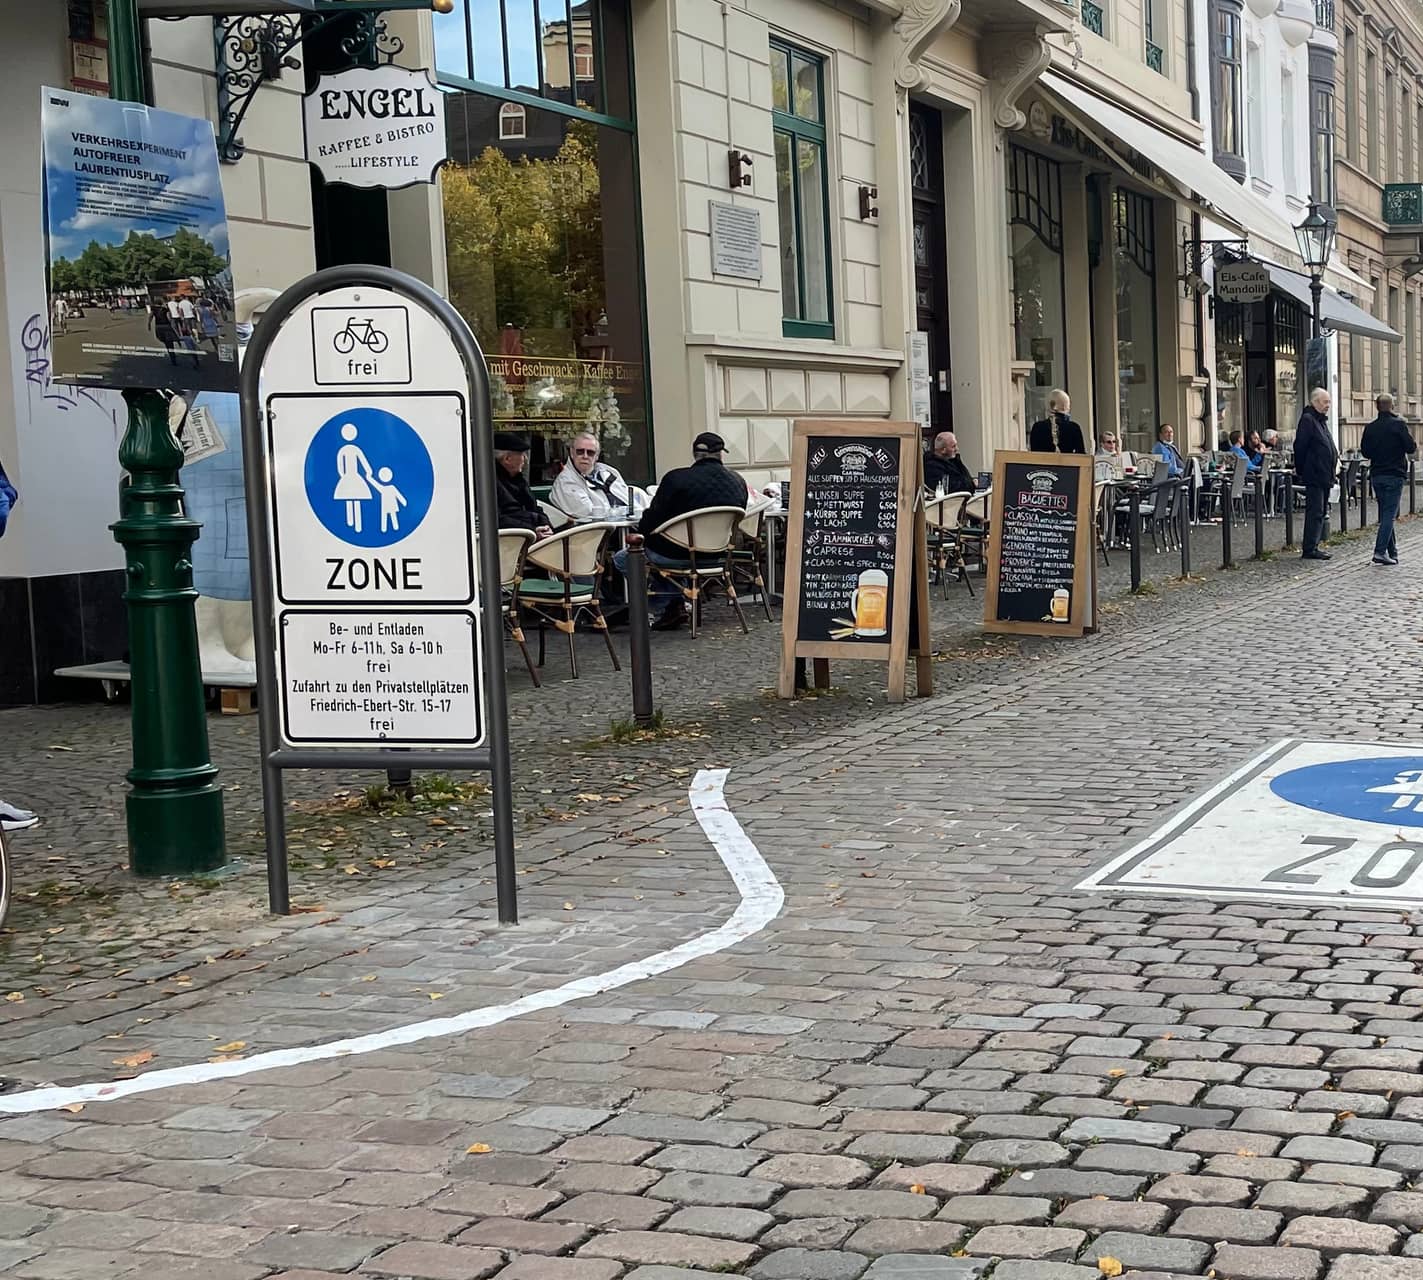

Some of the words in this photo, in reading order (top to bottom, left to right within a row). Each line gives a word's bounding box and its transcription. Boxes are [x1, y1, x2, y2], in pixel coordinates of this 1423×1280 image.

[320, 88, 436, 119] ENGEL
[72, 132, 186, 160] VERKEHRSEXPERIMENT
[318, 135, 371, 157] KAFFEE
[375, 133, 383, 144] &
[387, 122, 434, 142] BISTRO
[73, 147, 141, 166] AUTOFREIER
[75, 162, 171, 185] LAURENTIUSPLATZ
[348, 359, 377, 375] frei
[490, 360, 510, 377] mit
[512, 360, 574, 378] Geschmack
[583, 363, 614, 380] Kaffee
[809, 448, 826, 468] NEU
[874, 448, 893, 470] NEU
[821, 475, 844, 483] SUPPEN
[814, 490, 840, 500] LINSEN
[843, 490, 865, 500] SUPPE
[1021, 493, 1065, 507] BAGUETTES
[823, 501, 865, 509] METTWURST
[841, 510, 863, 519] SUPPE
[823, 519, 848, 528] LACHS
[813, 546, 855, 556] CAPRESE
[326, 558, 423, 590] ZONE
[329, 622, 349, 636] Be-
[354, 622, 373, 636] und
[378, 622, 424, 636] Entladen
[313, 641, 346, 655] Mo-Fr
[391, 641, 404, 655] Sa
[366, 660, 391, 673] frei
[292, 679, 330, 693] Zufahrt
[335, 683, 348, 693] zu
[352, 680, 371, 693] den
[376, 680, 469, 697] Privatstellplätzen
[310, 698, 417, 713] Friedrich-Ebert-Str.
[422, 699, 452, 713] 15-17
[370, 717, 395, 731] frei
